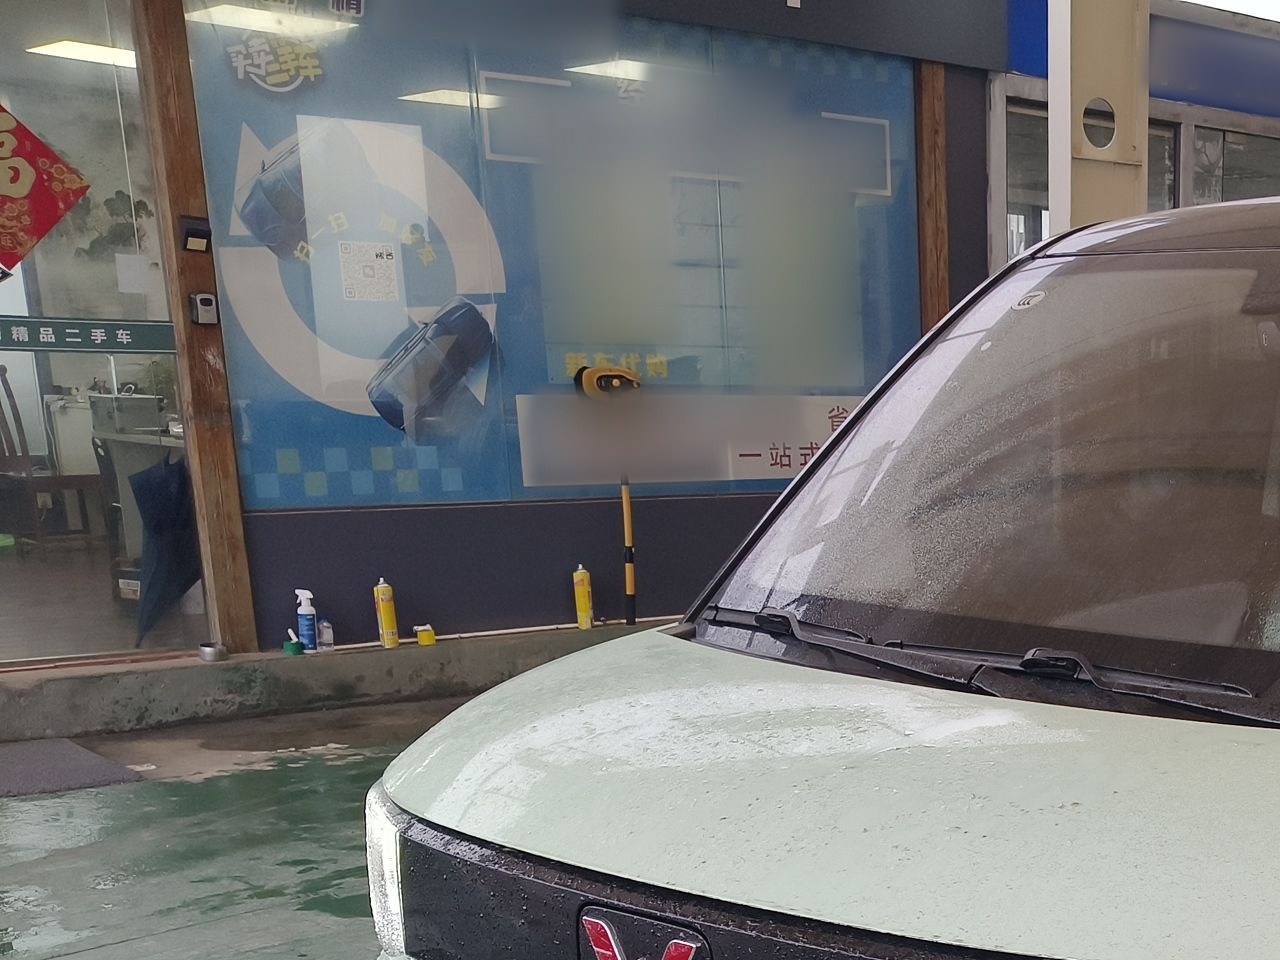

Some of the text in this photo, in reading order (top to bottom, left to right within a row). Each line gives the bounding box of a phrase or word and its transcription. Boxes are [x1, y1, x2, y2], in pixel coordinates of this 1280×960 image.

[0, 326, 132, 344] 精品二手车
